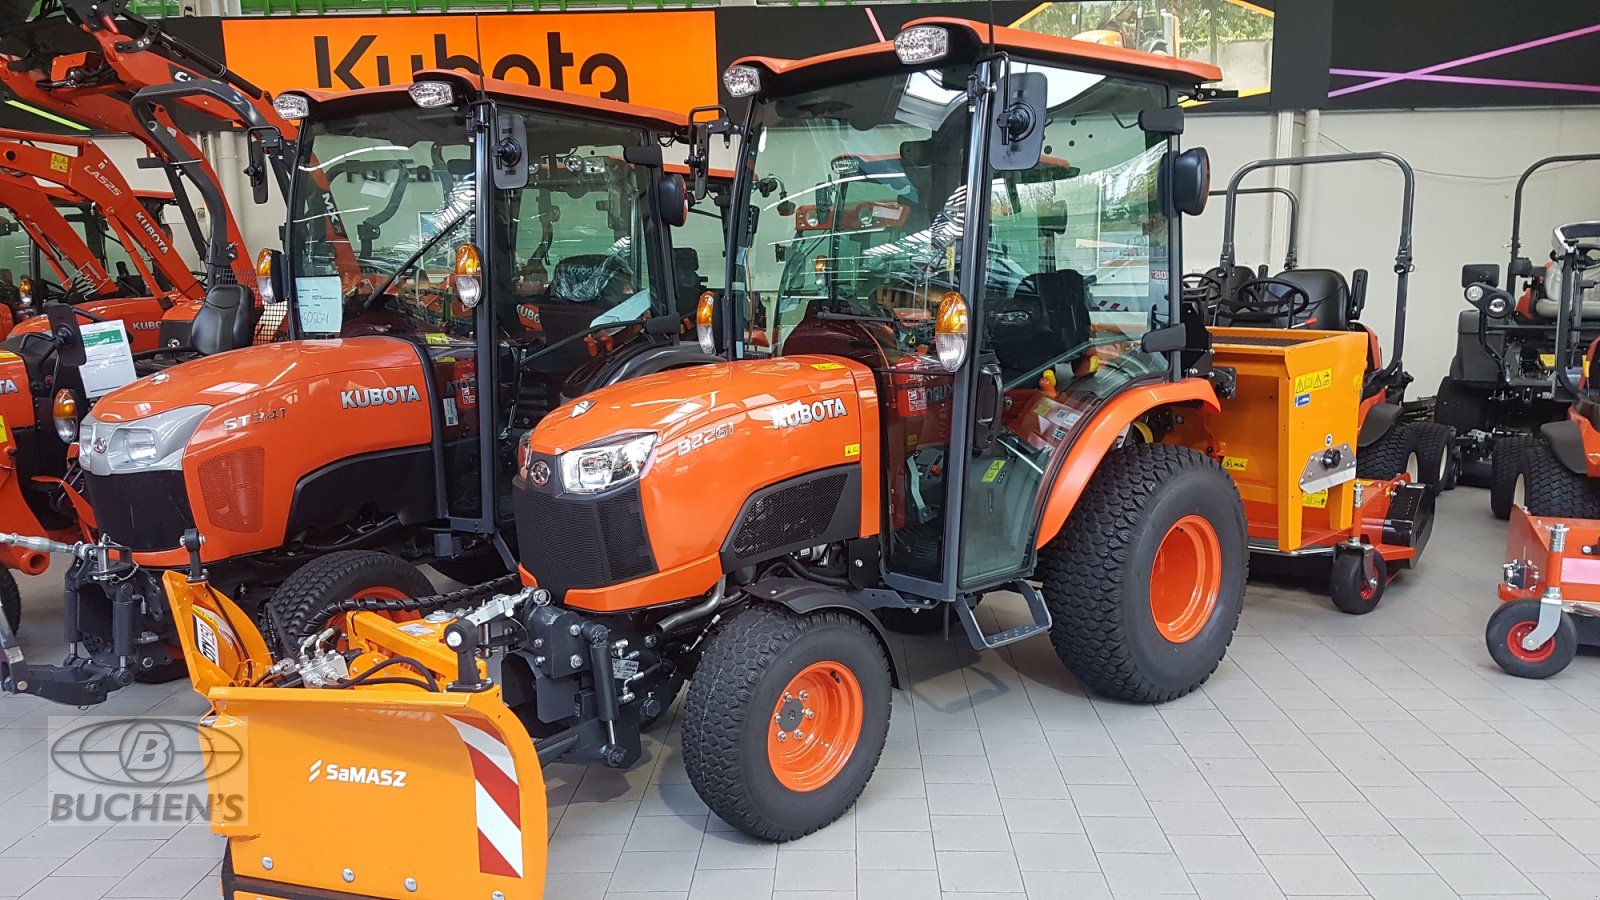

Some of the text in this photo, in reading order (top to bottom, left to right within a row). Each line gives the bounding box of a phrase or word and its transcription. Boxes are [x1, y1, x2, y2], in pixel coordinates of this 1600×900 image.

[313, 31, 630, 103] Kubota
[83, 165, 122, 197] LA525
[135, 211, 169, 255] KUBOTA
[340, 385, 421, 409] KUBOTA
[772, 398, 848, 430] KUBOTA
[677, 421, 735, 456] B2261
[326, 764, 407, 787] SaMASZ
